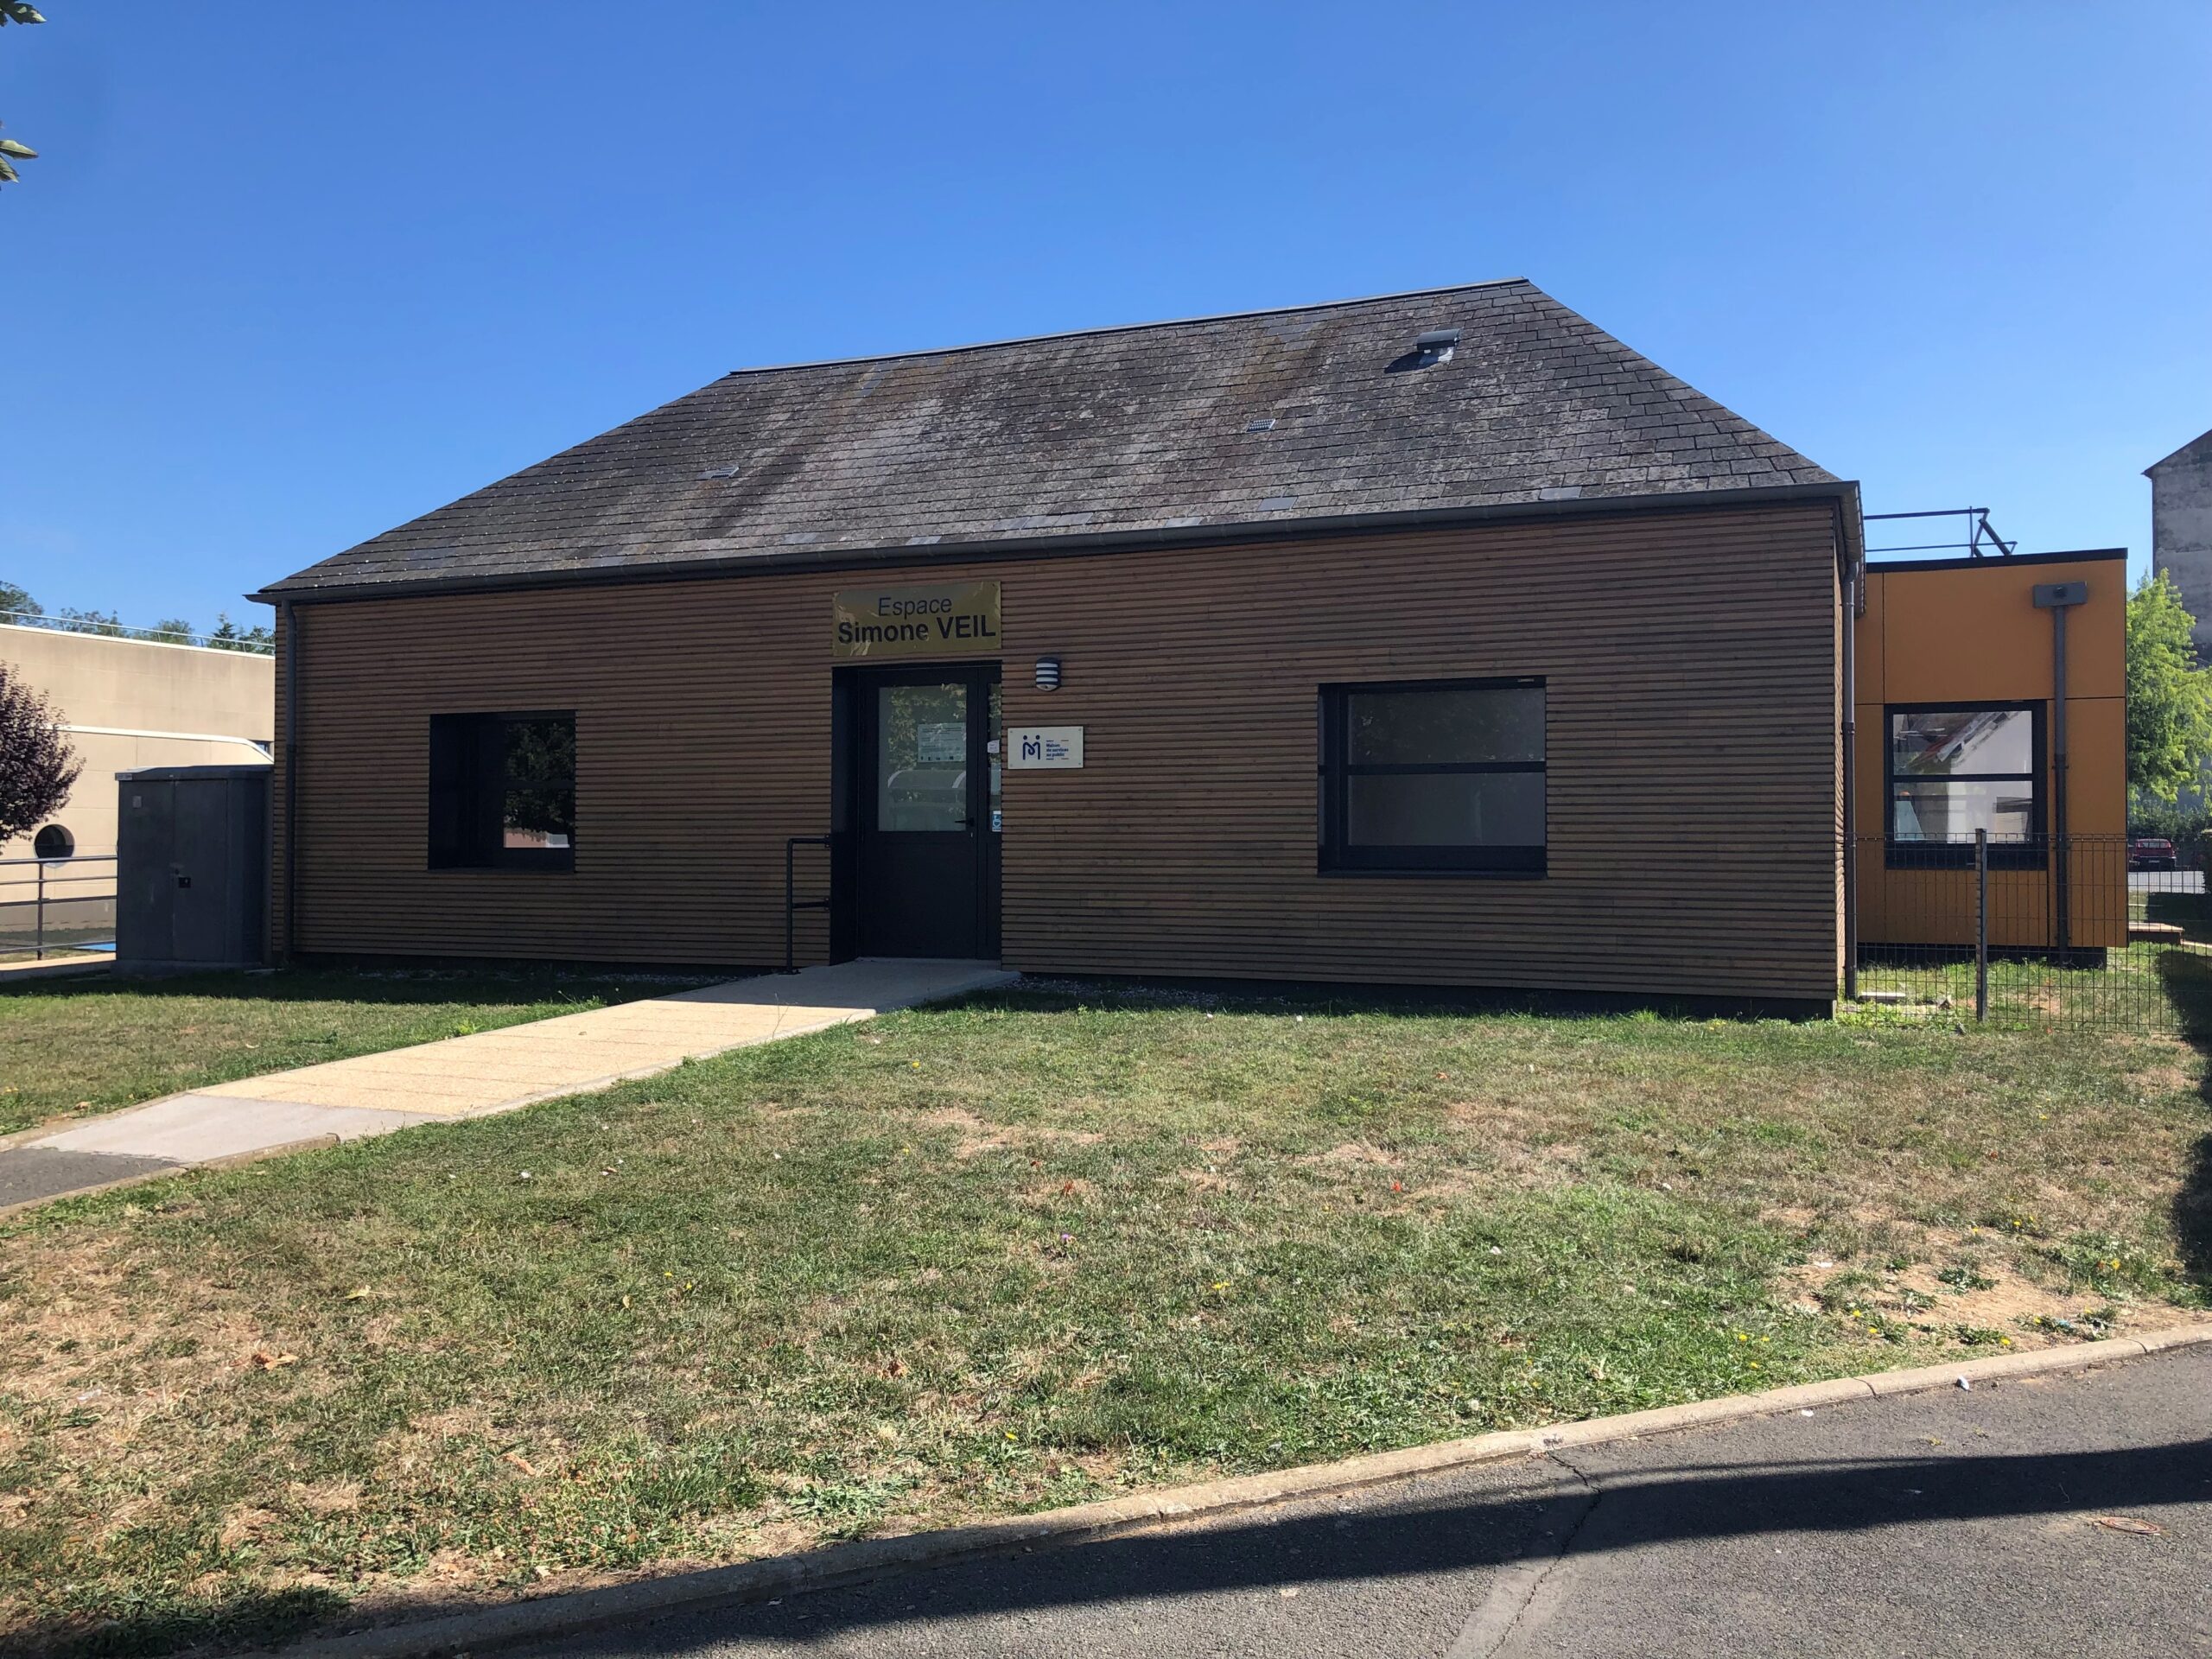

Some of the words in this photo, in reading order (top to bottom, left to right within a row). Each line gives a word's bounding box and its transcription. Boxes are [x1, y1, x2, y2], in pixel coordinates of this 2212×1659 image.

[878, 597, 952, 620] Espace
[838, 621, 929, 644] Simone
[937, 614, 996, 639] VEIL
